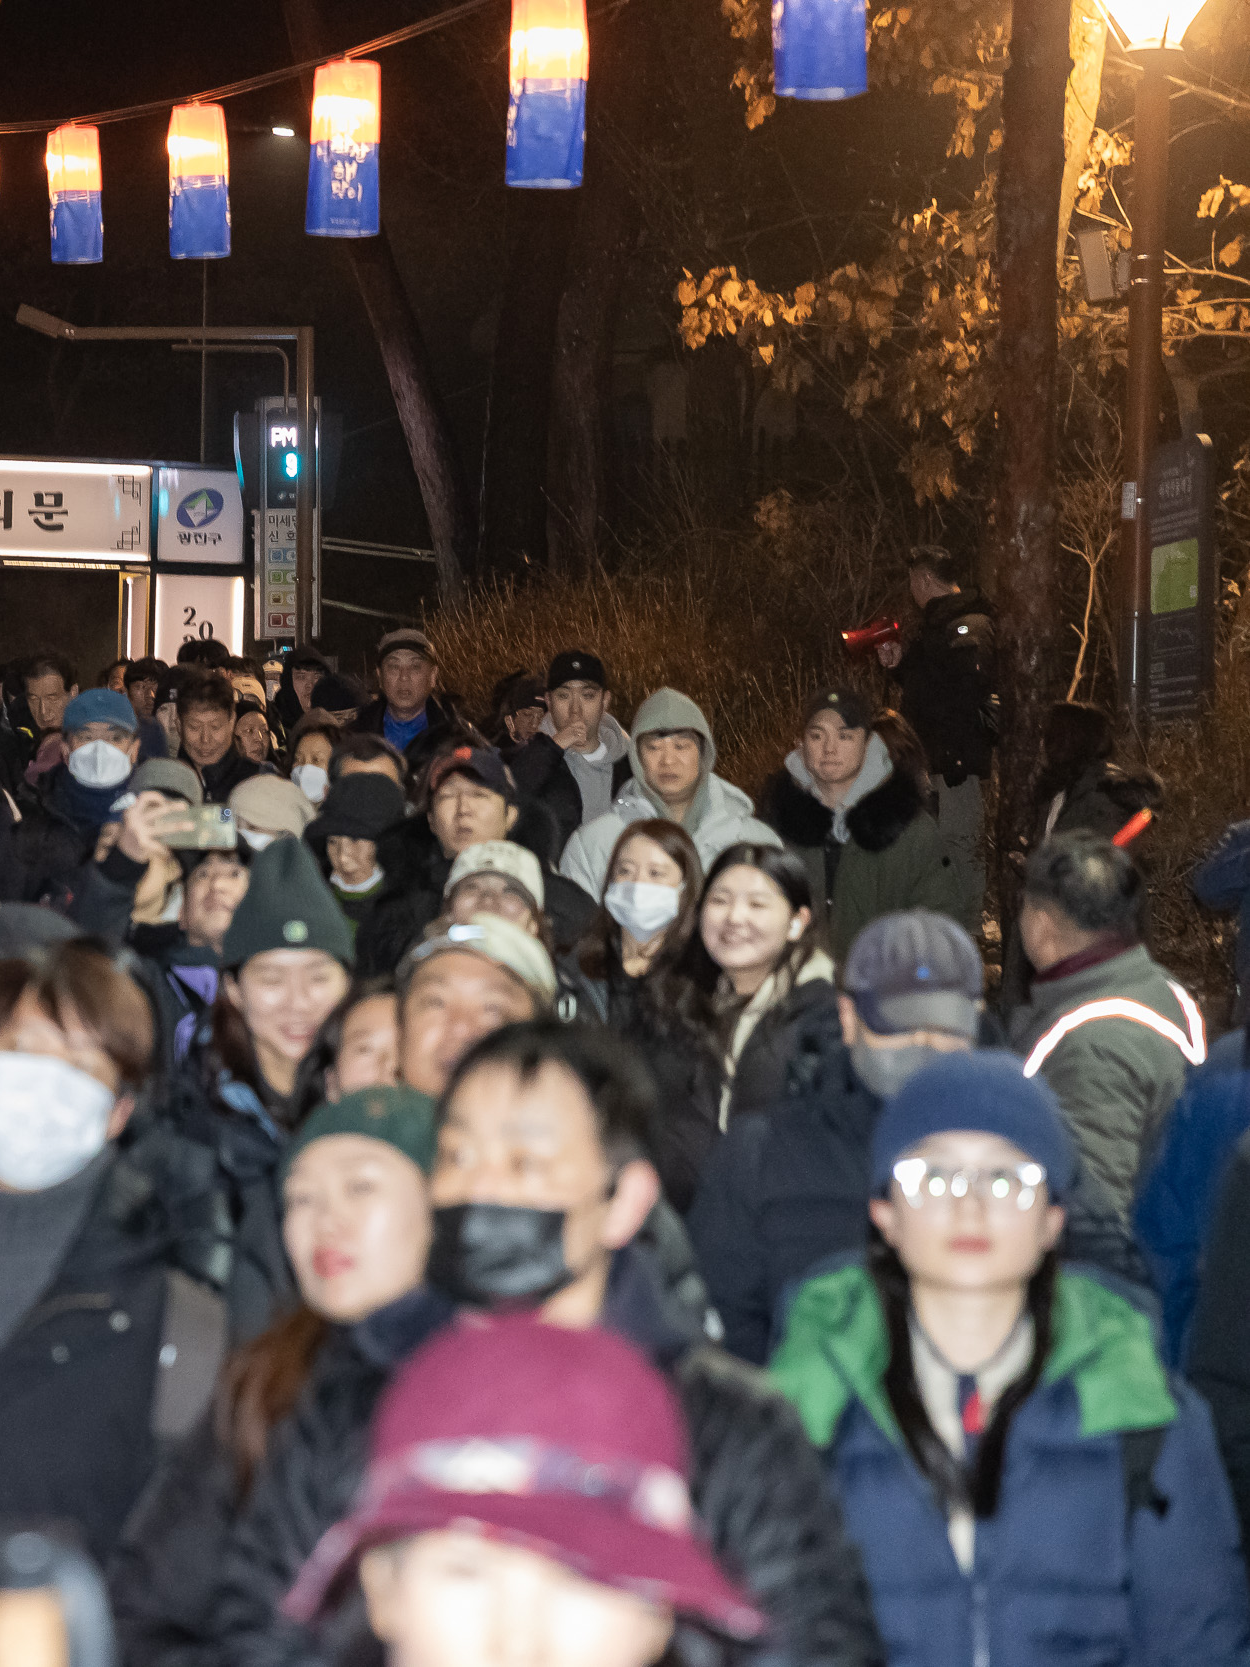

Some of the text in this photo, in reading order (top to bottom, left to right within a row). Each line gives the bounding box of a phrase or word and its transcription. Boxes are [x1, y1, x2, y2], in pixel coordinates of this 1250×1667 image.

[271, 427, 298, 448] PM
[27, 491, 69, 531] 문
[268, 514, 297, 528] 미세
